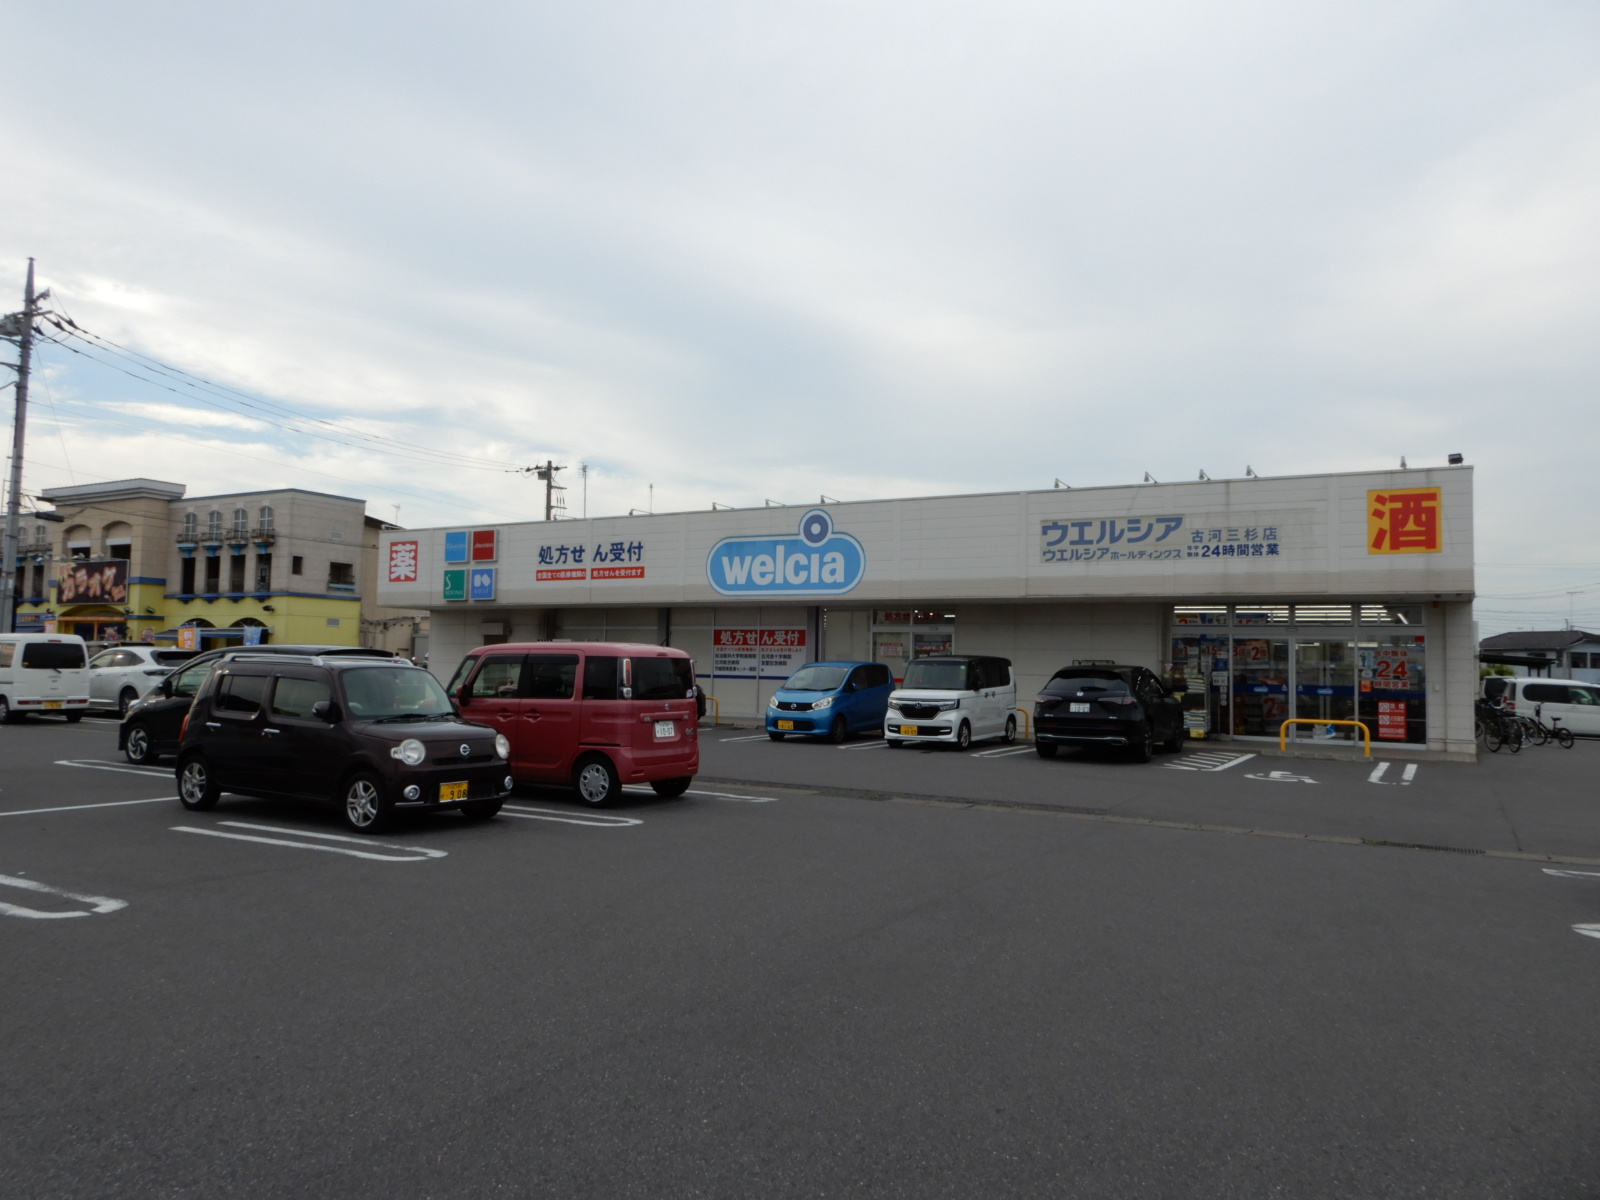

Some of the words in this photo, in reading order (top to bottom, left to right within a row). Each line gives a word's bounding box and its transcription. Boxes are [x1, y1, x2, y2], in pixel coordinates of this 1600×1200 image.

[1042, 516, 1183, 546] ウエルシア
[1372, 492, 1437, 550] 酒
[1190, 526, 1278, 544] 古河三杉店
[538, 541, 644, 565] 処方せん受付
[1042, 547, 1182, 563] ウエルシアホールディングス
[1201, 542, 1280, 558] 24時間営業
[390, 543, 416, 580] 薬
[722, 544, 845, 586] welcia
[720, 630, 800, 645] 処方せん受付
[1376, 660, 1409, 678] 24
